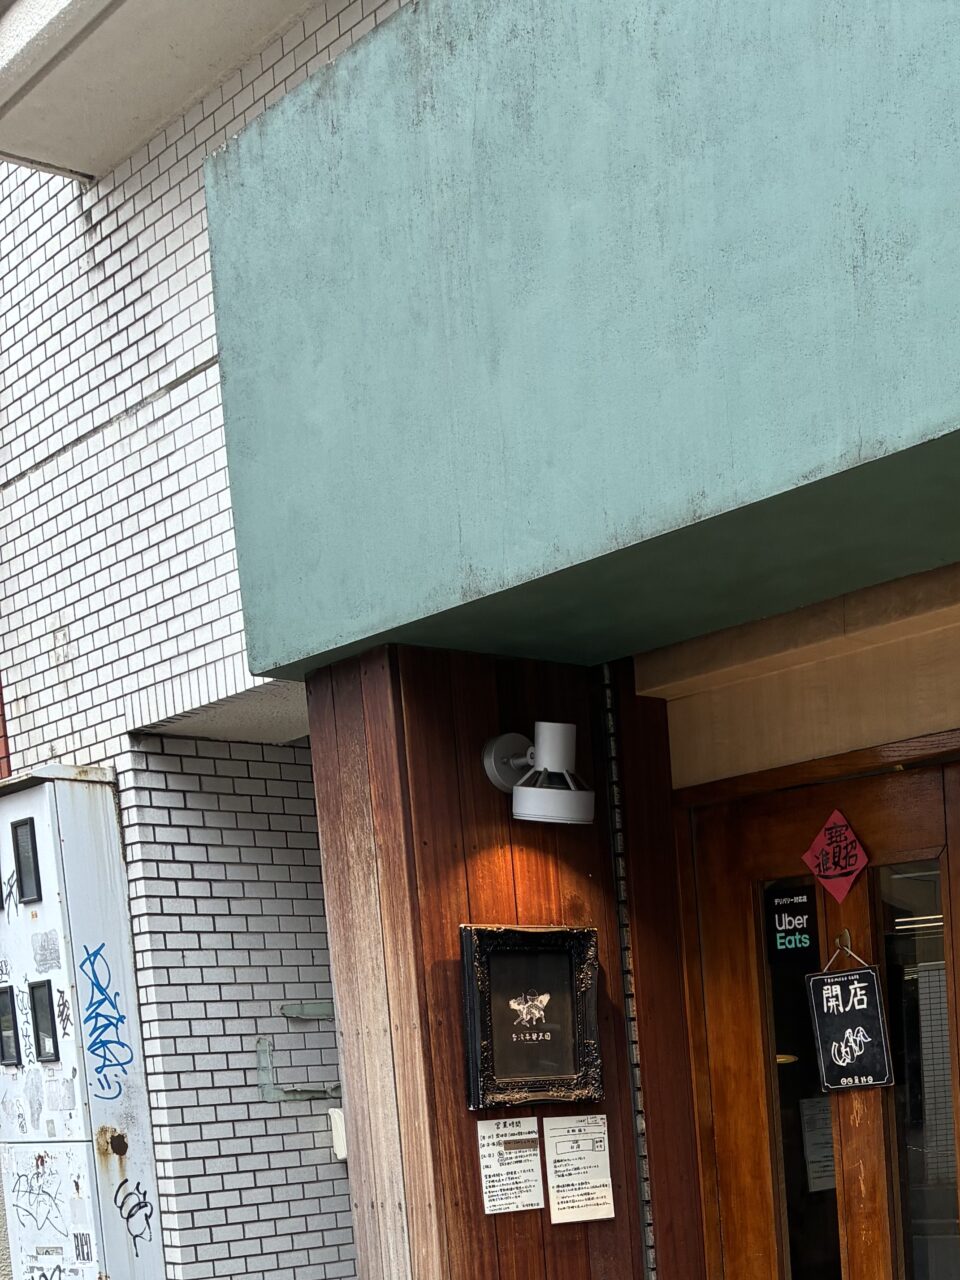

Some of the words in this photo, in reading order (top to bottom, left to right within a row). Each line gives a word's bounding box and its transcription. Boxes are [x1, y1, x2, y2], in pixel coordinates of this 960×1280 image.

[775, 913, 808, 930] Uber
[776, 932, 810, 949] Eats
[822, 980, 869, 1015] 開店
